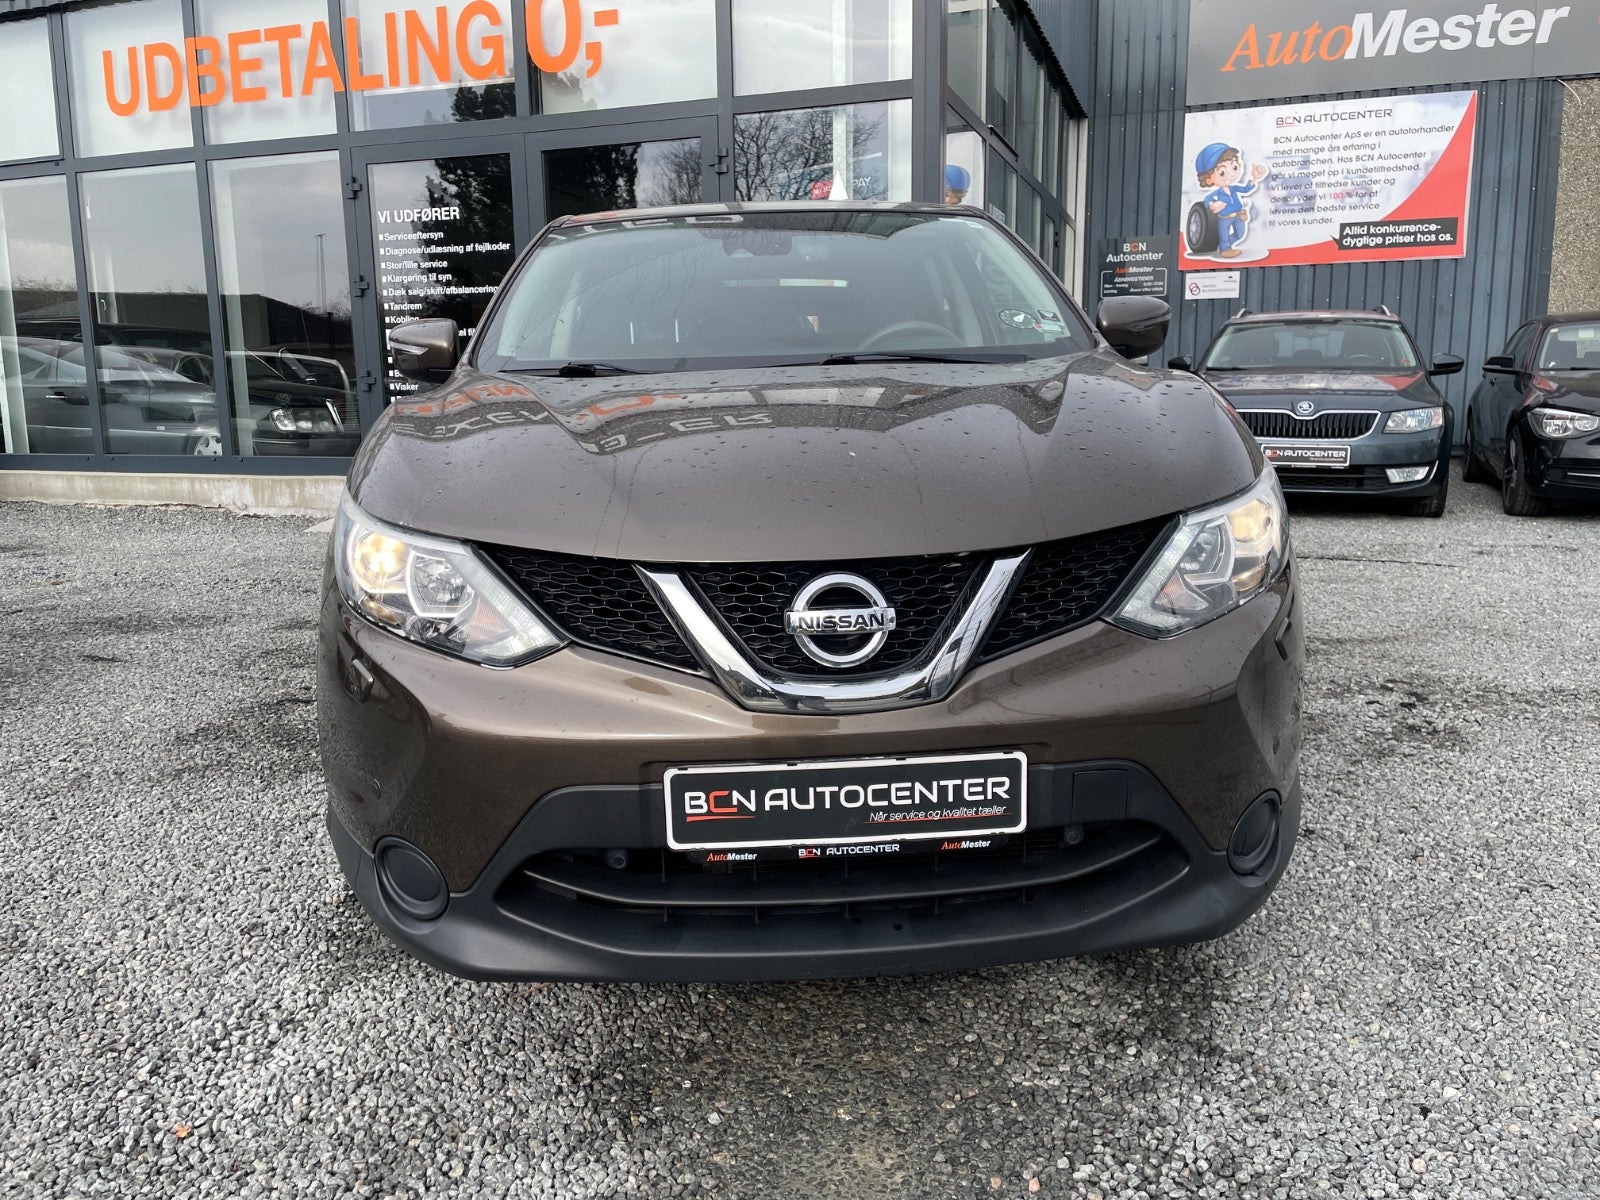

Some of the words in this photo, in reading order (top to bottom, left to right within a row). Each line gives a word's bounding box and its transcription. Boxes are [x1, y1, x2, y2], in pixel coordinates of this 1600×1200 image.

[1220, 3, 1571, 72] AutoMester
[103, 0, 505, 117] UDBETALING
[1275, 115, 1301, 127] BCN
[1303, 109, 1393, 124] AUTOCENTER
[1273, 135, 1292, 144] BCN
[1294, 132, 1342, 143] Autocenter
[1344, 130, 1362, 140] ApS
[1363, 130, 1372, 138] er
[1374, 129, 1387, 137] en
[1389, 125, 1455, 136] autoforhandler
[1272, 147, 1293, 156] med
[1294, 146, 1326, 157] mange
[1328, 143, 1341, 153] års
[1342, 142, 1376, 153] erfaring
[1272, 157, 1335, 168] autobranchen.
[1337, 155, 1354, 164] Hos
[1355, 153, 1375, 162] BCN
[1377, 151, 1427, 161] Autocenter
[1297, 169, 1326, 179] meget
[1327, 169, 1340, 178] op
[1315, 180, 1348, 189] tilfredse
[1351, 178, 1381, 187] kunder
[1383, 178, 1396, 186] og
[1329, 191, 1344, 200] 100
[1355, 190, 1367, 198] for
[1298, 205, 1315, 213] den
[1316, 203, 1347, 212] bedste
[1349, 202, 1380, 210] service
[378, 210, 391, 223] VI
[394, 206, 460, 223] UDFØRER
[1302, 217, 1335, 225] kunder.
[1342, 225, 1368, 235] Altid
[1370, 222, 1442, 234] konkurrence-
[384, 232, 444, 242] Serviceeftersyn
[1342, 236, 1383, 247] dygtige
[1385, 234, 1415, 246] priser
[1417, 232, 1436, 242] hos
[1438, 232, 1454, 242] os.
[385, 245, 463, 256] Diagnose/udlæsning
[465, 243, 474, 252] af
[475, 242, 511, 253] fejlkoder
[1123, 242, 1147, 253] BCN
[1106, 252, 1164, 263] Autocenter
[386, 260, 418, 270] Stor/lille
[419, 260, 448, 268] service
[387, 273, 427, 284] Klargøring
[429, 272, 437, 282] til
[438, 273, 452, 283] syn
[388, 287, 406, 296] Dæk
[390, 302, 422, 311] Tandrem
[395, 382, 419, 391] Visker
[1284, 450, 1346, 458] AUTOCENTER
[797, 613, 885, 630] NISSAN
[685, 789, 756, 815] BCN
[764, 776, 1011, 811] AUTOCENTER
[869, 811, 888, 822] Når
[889, 809, 926, 821] service
[927, 810, 941, 820] og
[943, 806, 976, 817] kvalitet
[978, 805, 1007, 815] tæller
[941, 839, 991, 850] AutoMester
[798, 847, 821, 857] BCN
[826, 844, 900, 856] AUTOCENTER
[706, 851, 757, 862] AutoMester
